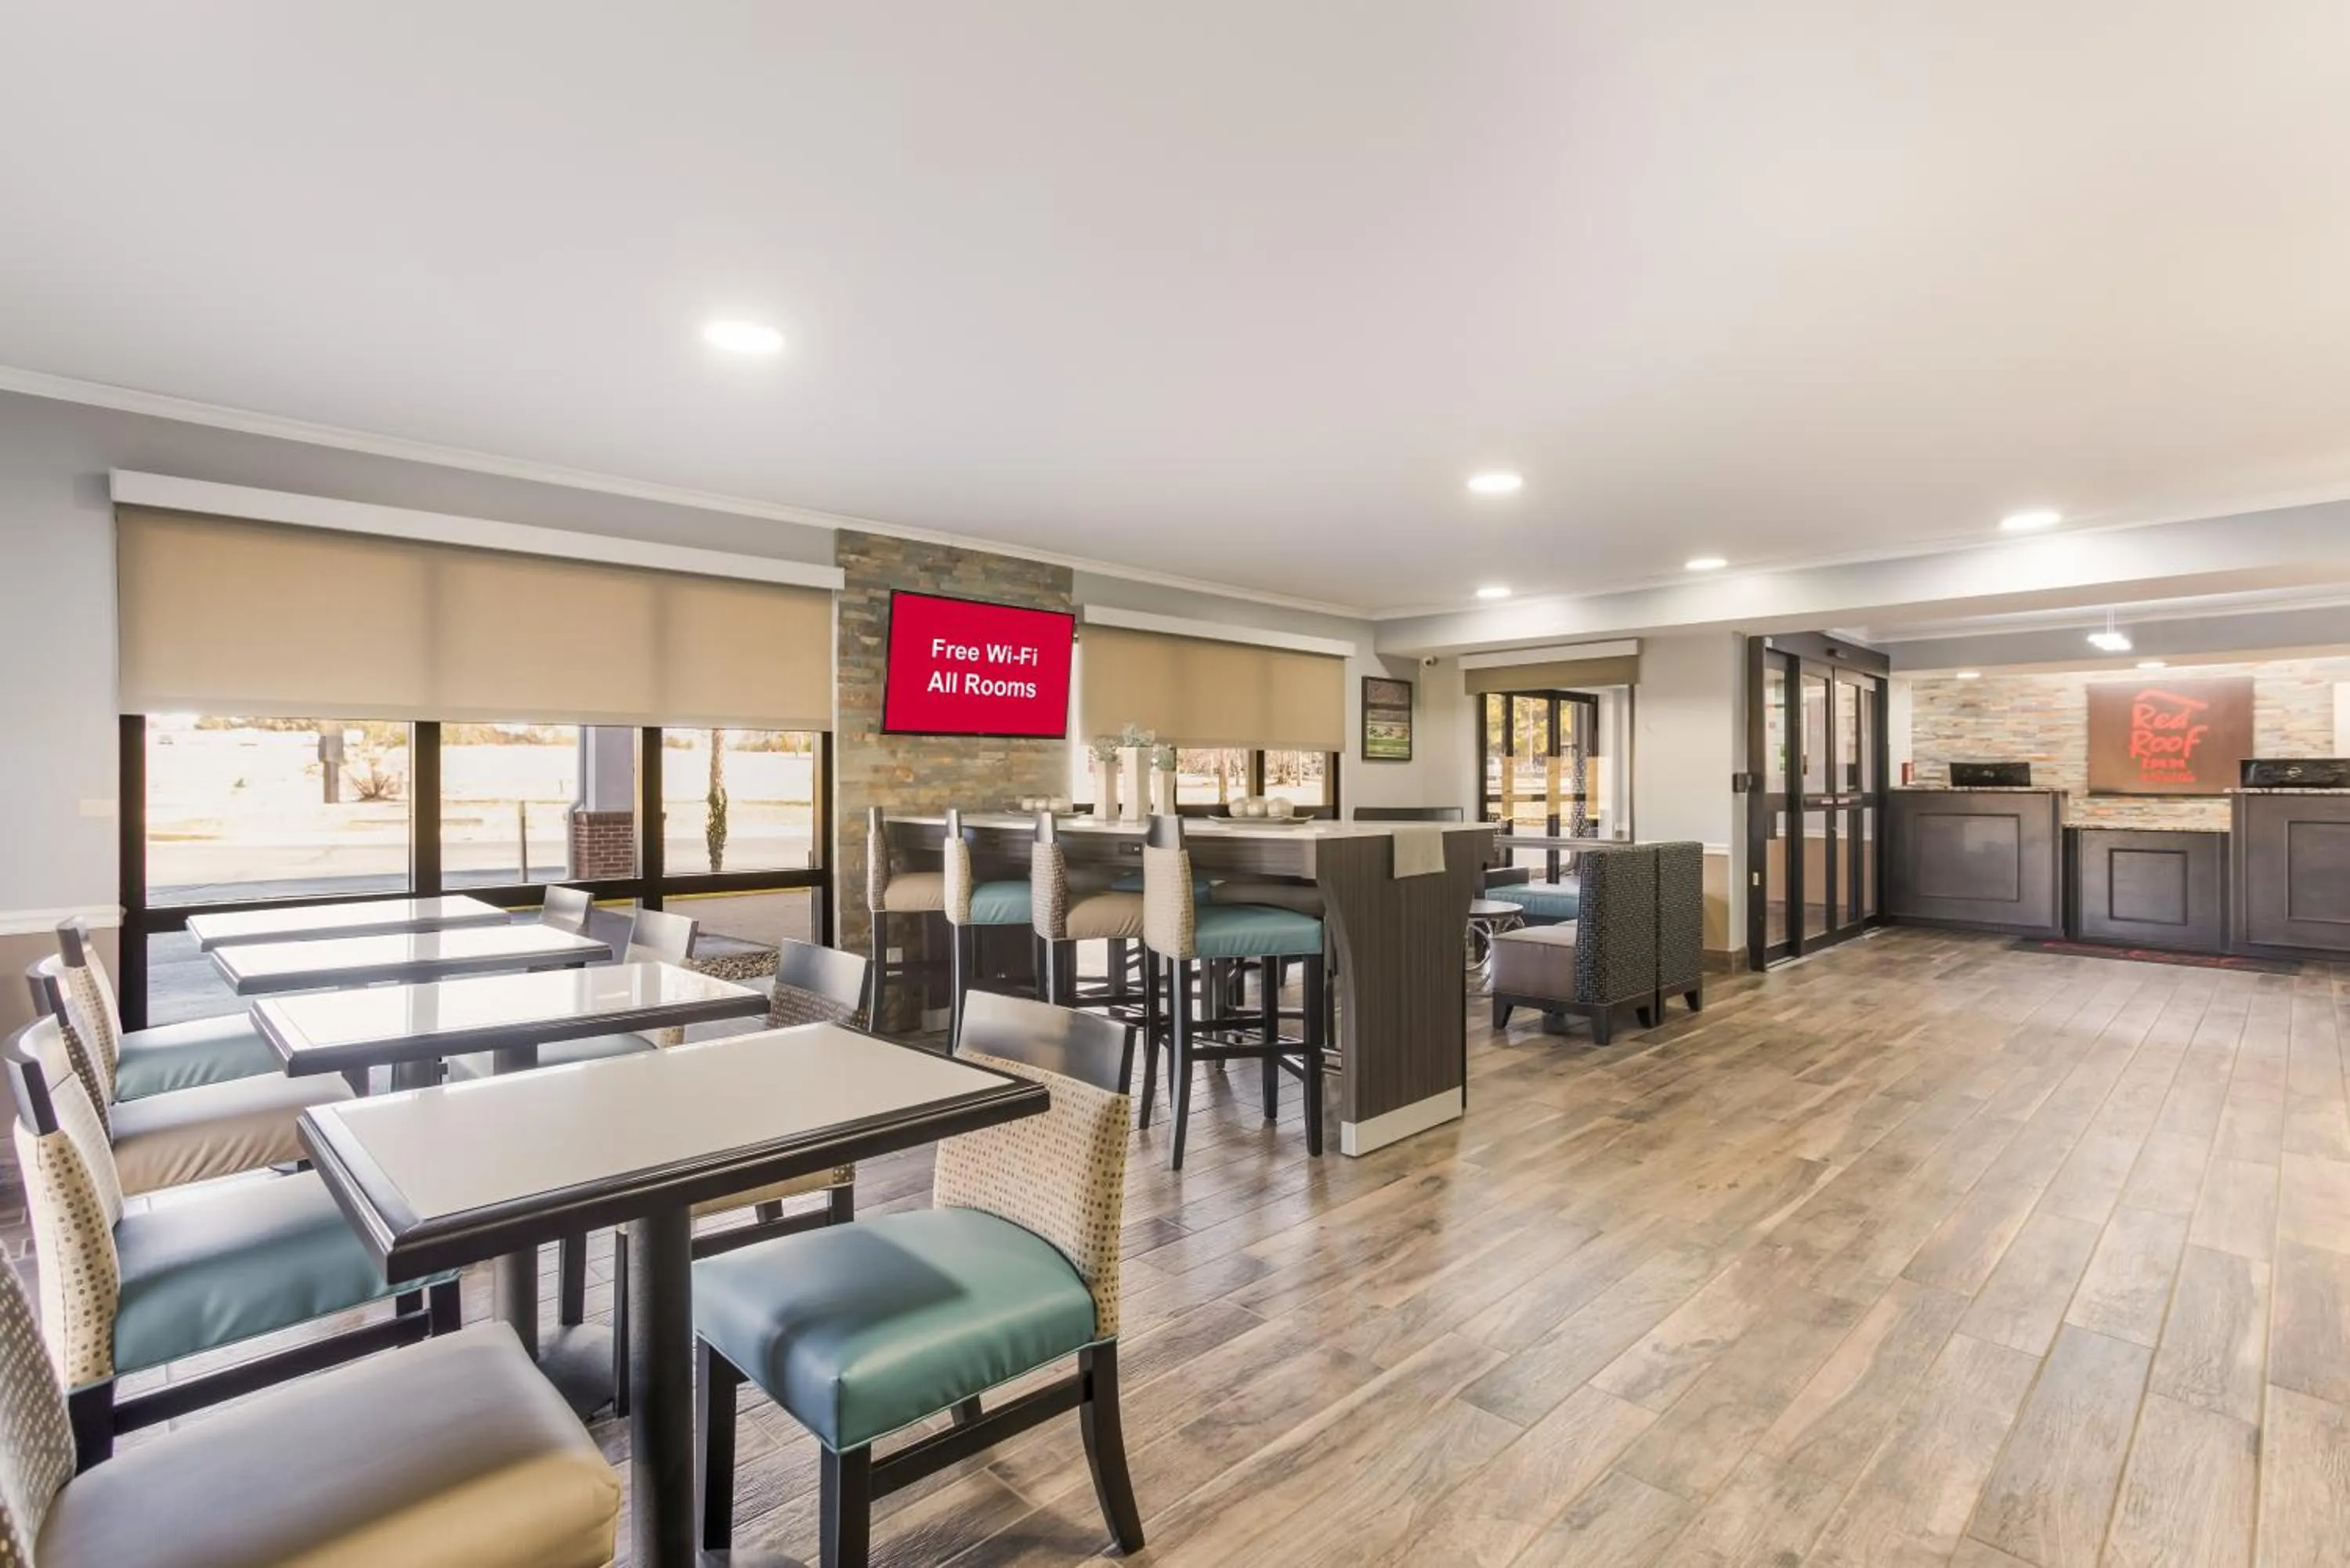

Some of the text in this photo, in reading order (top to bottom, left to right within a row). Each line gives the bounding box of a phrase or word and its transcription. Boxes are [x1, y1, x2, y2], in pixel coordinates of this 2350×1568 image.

[931, 638, 1038, 666] Free Wi-Fi
[927, 670, 1037, 699] All Rooms
[2131, 703, 2192, 730] Red
[2130, 724, 2209, 759] Roof
